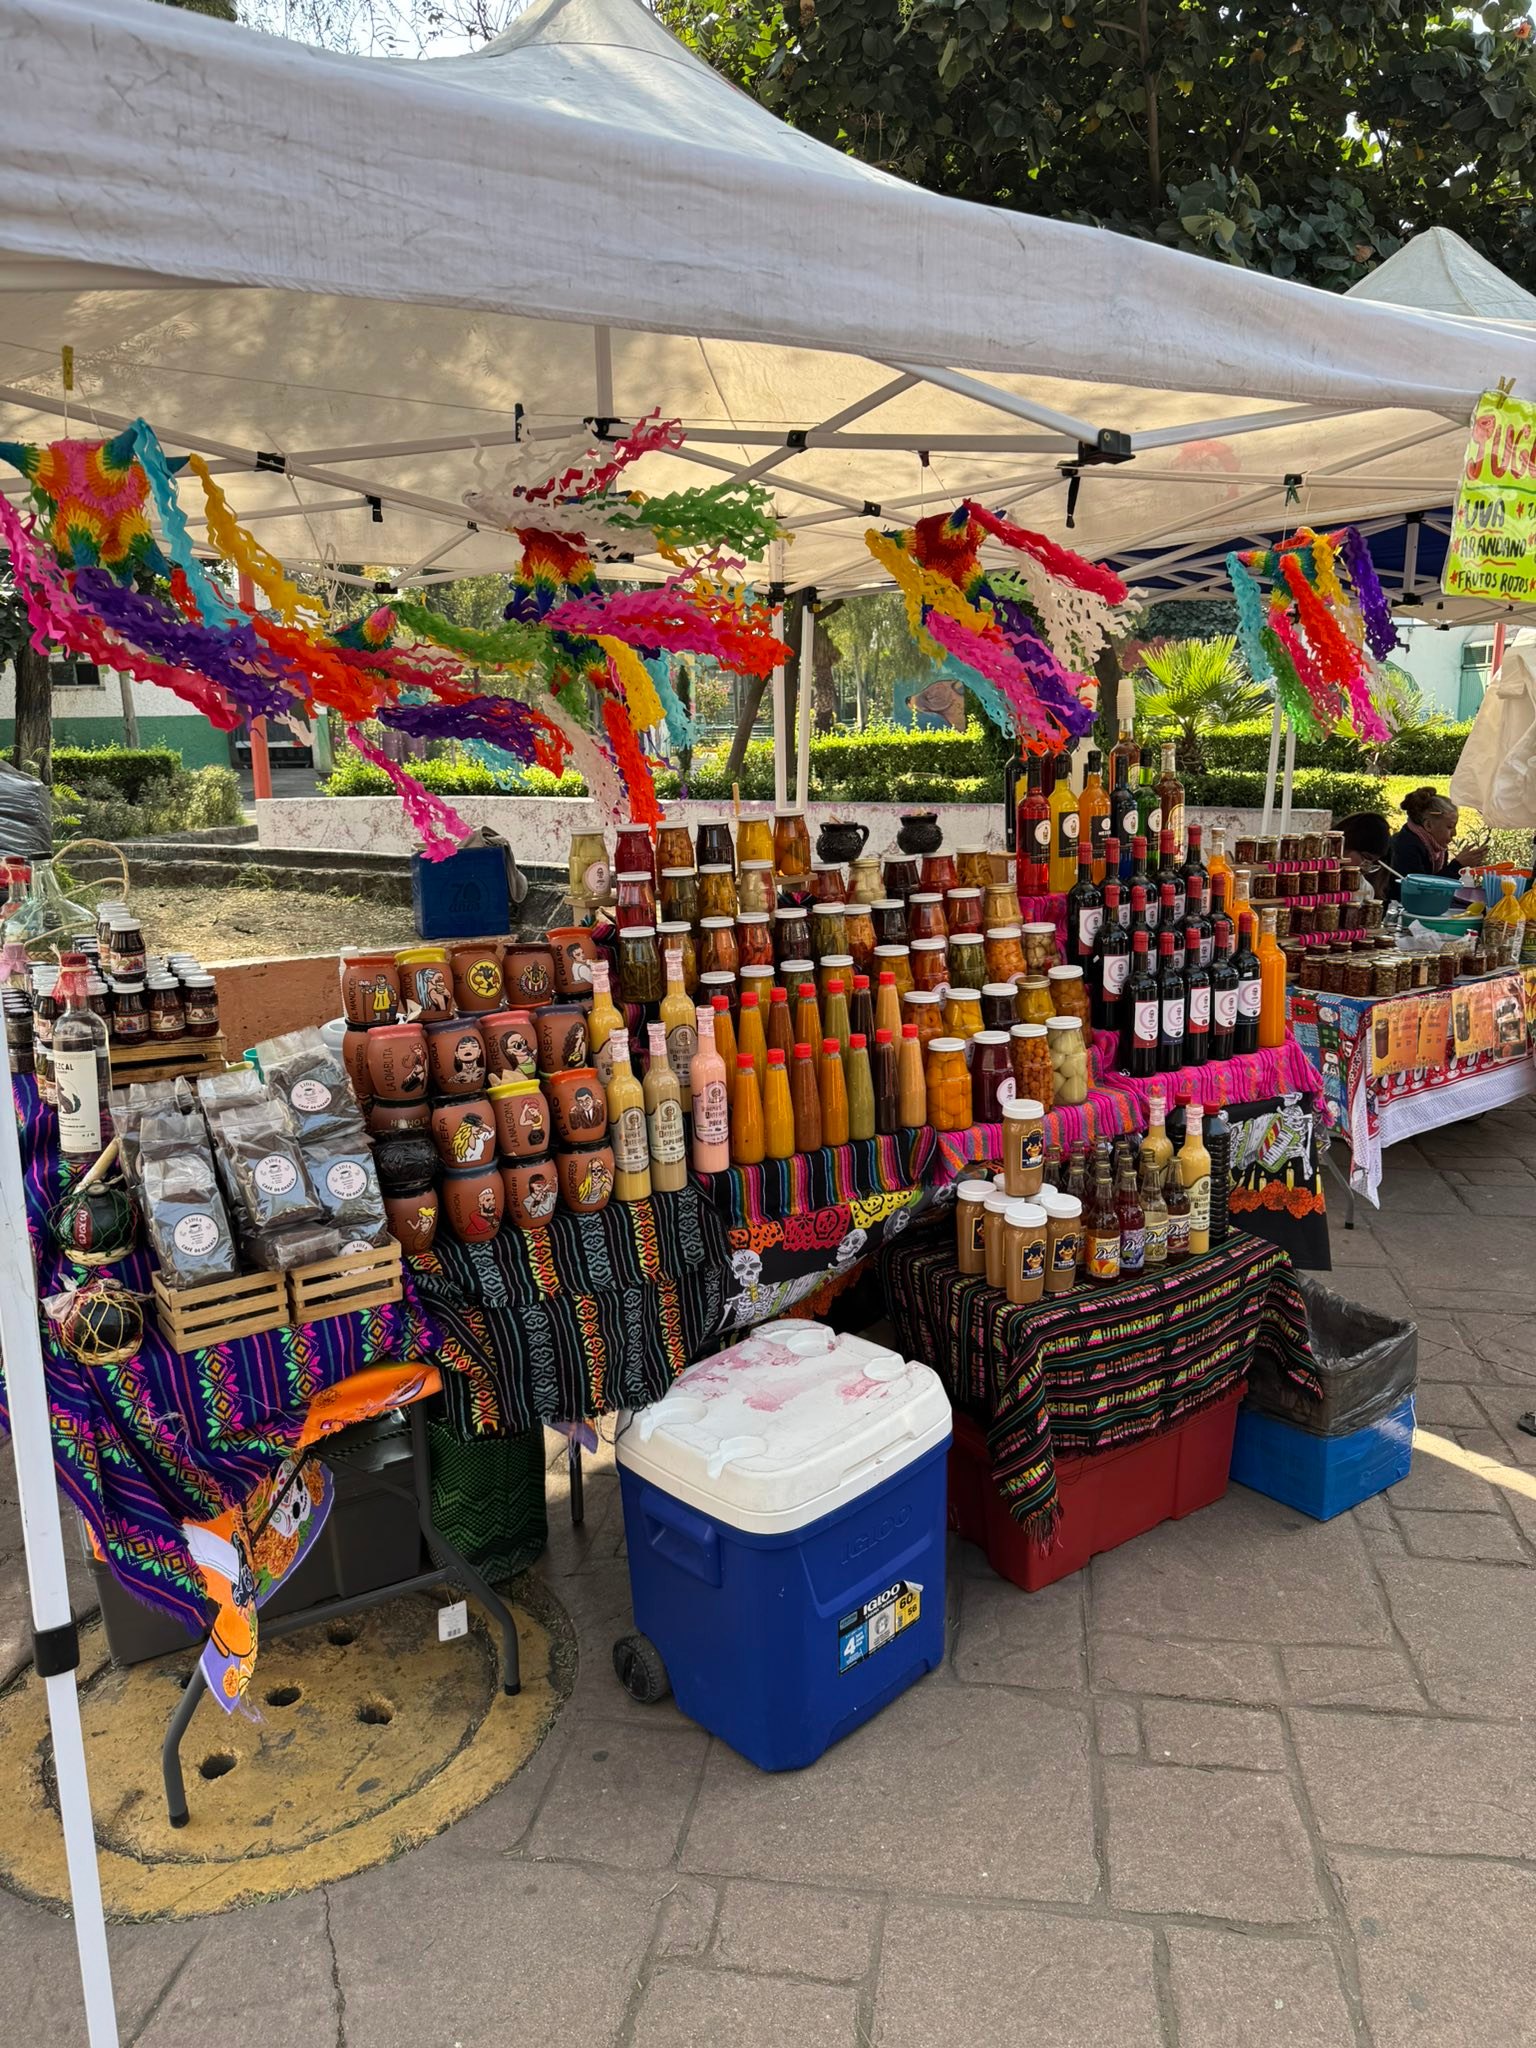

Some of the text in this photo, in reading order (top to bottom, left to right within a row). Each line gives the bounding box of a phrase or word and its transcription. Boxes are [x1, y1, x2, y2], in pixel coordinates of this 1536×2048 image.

[1464, 498, 1505, 528] UVA
[1458, 570, 1529, 593] FRUTOS ROJOS
[556, 944, 566, 977] GUAPO
[431, 1042, 440, 1070] CHOLA
[488, 1033, 498, 1065] FRESA
[544, 1025, 554, 1066] LA SEXY
[383, 1047, 396, 1091] LA DIABLITA
[440, 1117, 451, 1146] JEFA
[503, 1101, 520, 1147] LA NALGONA
[553, 1097, 570, 1136] EL FEO
[863, 1583, 901, 1616] IGLOO
[900, 1592, 913, 1609] 60
[908, 1604, 917, 1615] 56
[844, 1636, 855, 1657] 4
